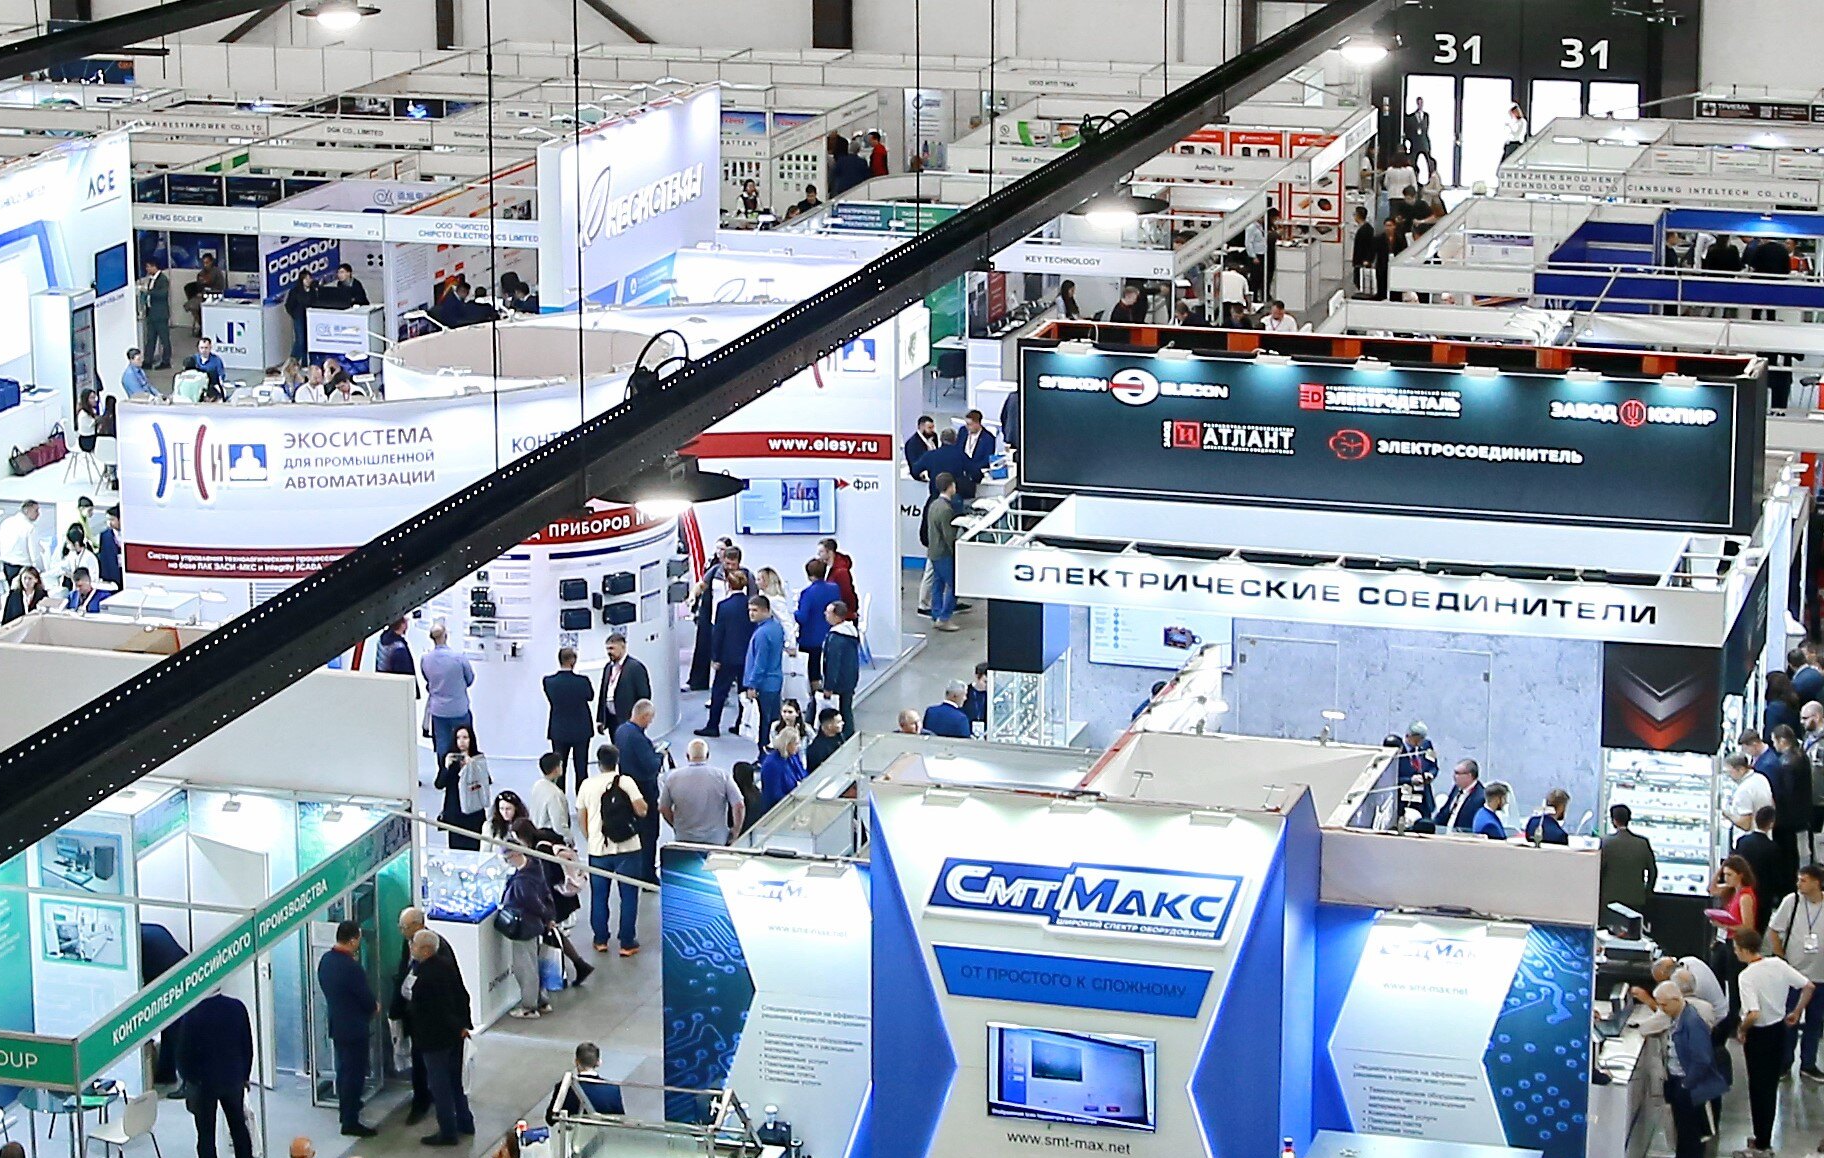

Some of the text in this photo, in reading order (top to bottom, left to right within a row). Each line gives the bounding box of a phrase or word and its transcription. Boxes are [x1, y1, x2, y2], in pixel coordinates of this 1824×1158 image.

[1433, 34, 1483, 64] 31
[1560, 38, 1610, 69] 31
[86, 169, 115, 199] ACE
[1500, 172, 1556, 181] SHENZHEN
[1500, 181, 1572, 191] TECHNOLOGY
[1025, 255, 1043, 265] KEY
[1044, 255, 1101, 267] TECHNOLOGY
[1323, 389, 1461, 413] ЭЛЕКТРОДЕТАЛЬ
[1550, 400, 1717, 426] ЗАВОД КОПИР
[283, 426, 433, 450] ЭКОСИСТЕМА
[768, 435, 879, 455] www.elesy.ru
[1202, 427, 1294, 453] АТЛАНТ
[283, 449, 436, 470] ДЛЯ ПРОМЫШЛЕННОЙ
[1377, 439, 1584, 465] ЭЛЕКТРОСОЕДИНИТЕЛЬ
[283, 468, 436, 490] АВТОМАТИЗАЦИИ
[852, 478, 879, 491] фрп
[548, 513, 632, 538] ПРИБОРОВ
[1013, 563, 1658, 626] ЭЛЕКТРИЧЕСКИЕ СОЕДИНИТЕЛИ
[1055, 917, 1216, 939] ШИРОКИЙ СПЕКТР ОБОРУДОВАНИЯ
[111, 877, 329, 1048] КОНТРОЛЛЕРЫ РОССИЙСКОГО ПРОИЗВОДСТВА
[960, 964, 1187, 998] ОТ ПРОСТОГО К СЛОЖНОМУ
[1005, 1130, 1132, 1156] www.smt-max.net
